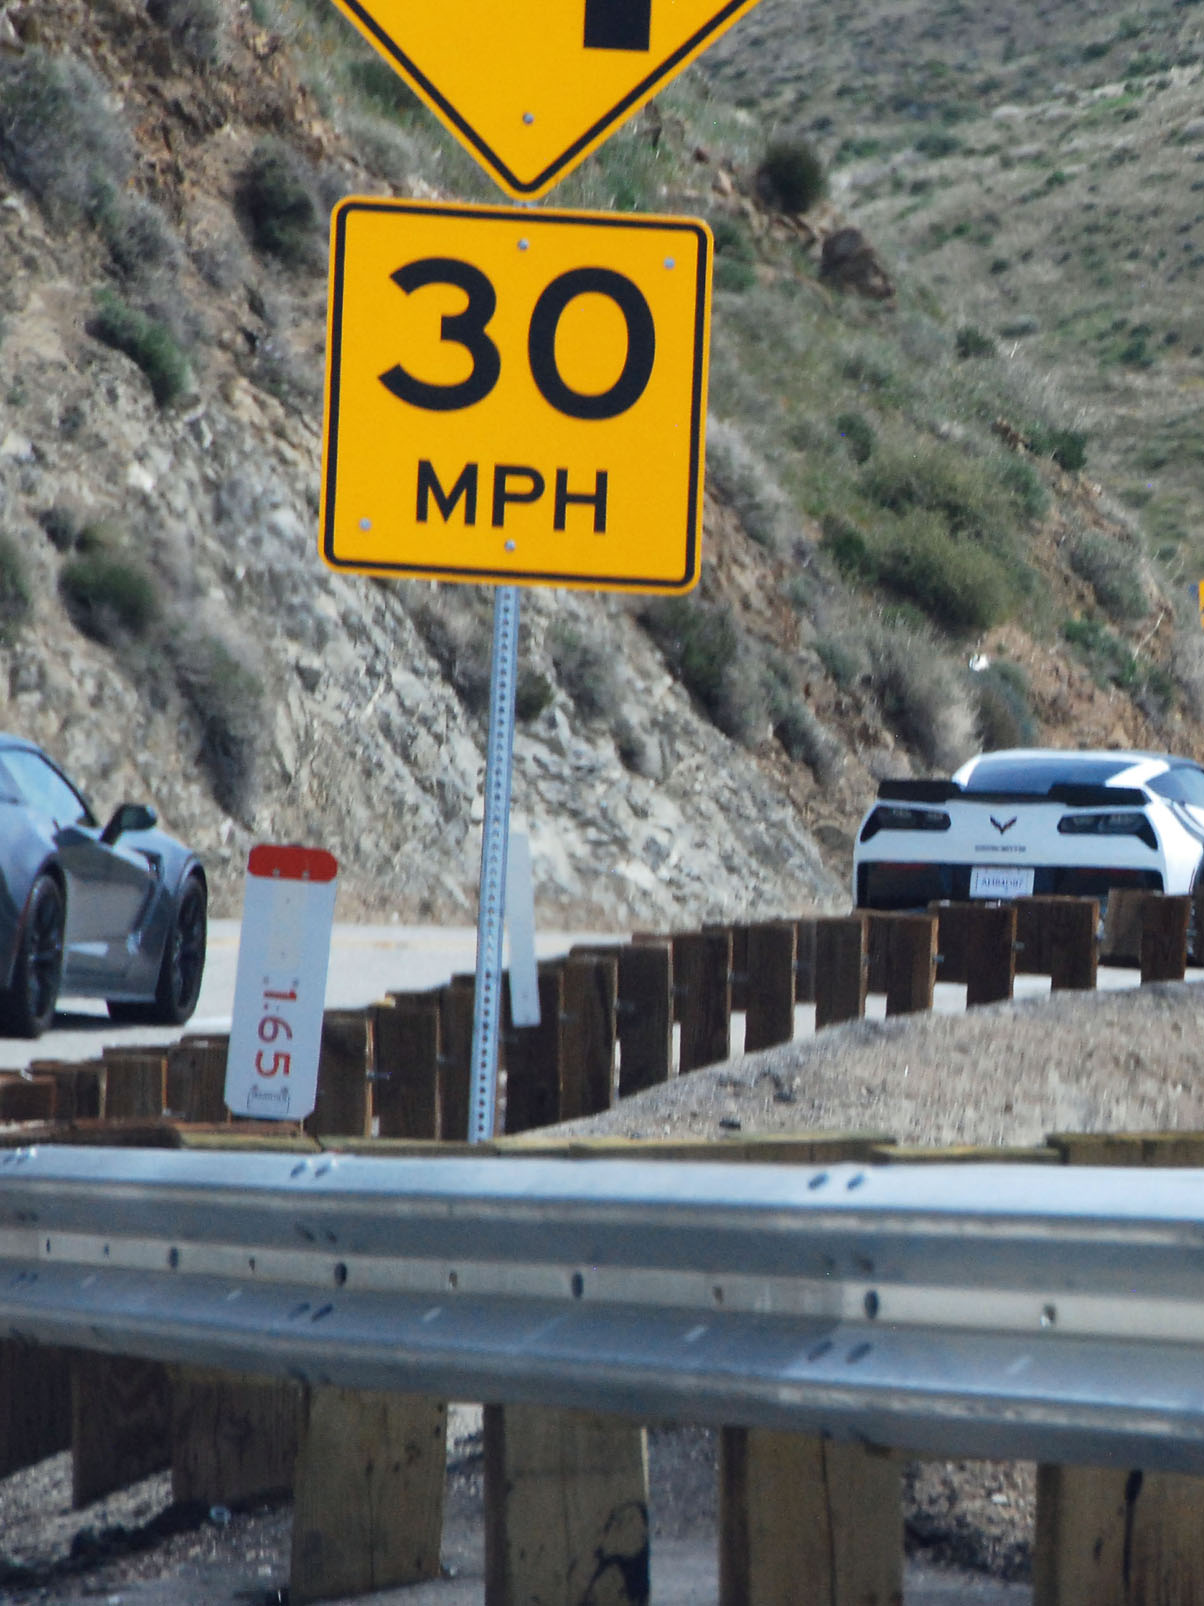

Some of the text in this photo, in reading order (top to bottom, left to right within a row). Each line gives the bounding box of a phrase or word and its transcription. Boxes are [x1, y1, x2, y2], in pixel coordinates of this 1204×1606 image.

[378, 257, 656, 421] 30
[415, 459, 608, 534] MPH
[254, 989, 297, 1078] 1.65
